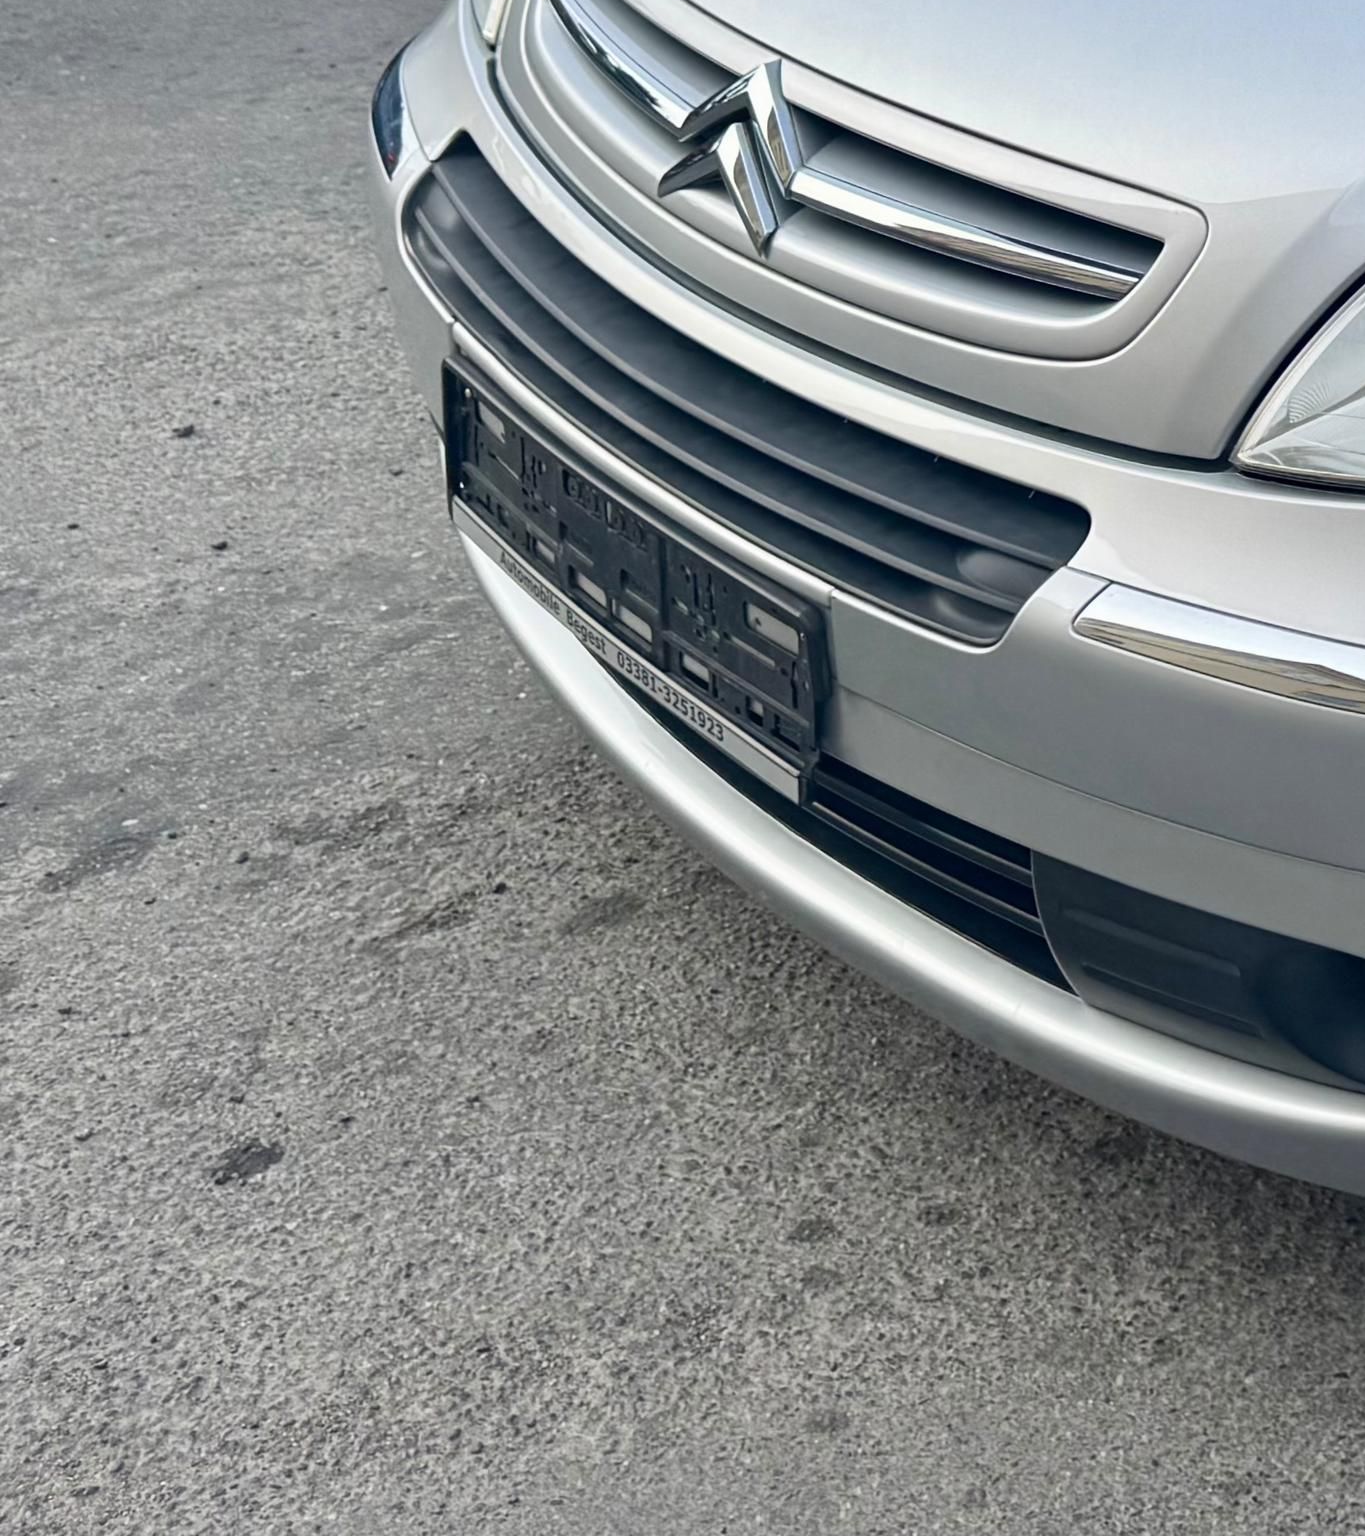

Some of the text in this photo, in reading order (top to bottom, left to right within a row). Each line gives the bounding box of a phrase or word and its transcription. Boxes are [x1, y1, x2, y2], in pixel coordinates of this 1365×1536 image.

[501, 550, 725, 743] Automobile Begest 03381-3251923
